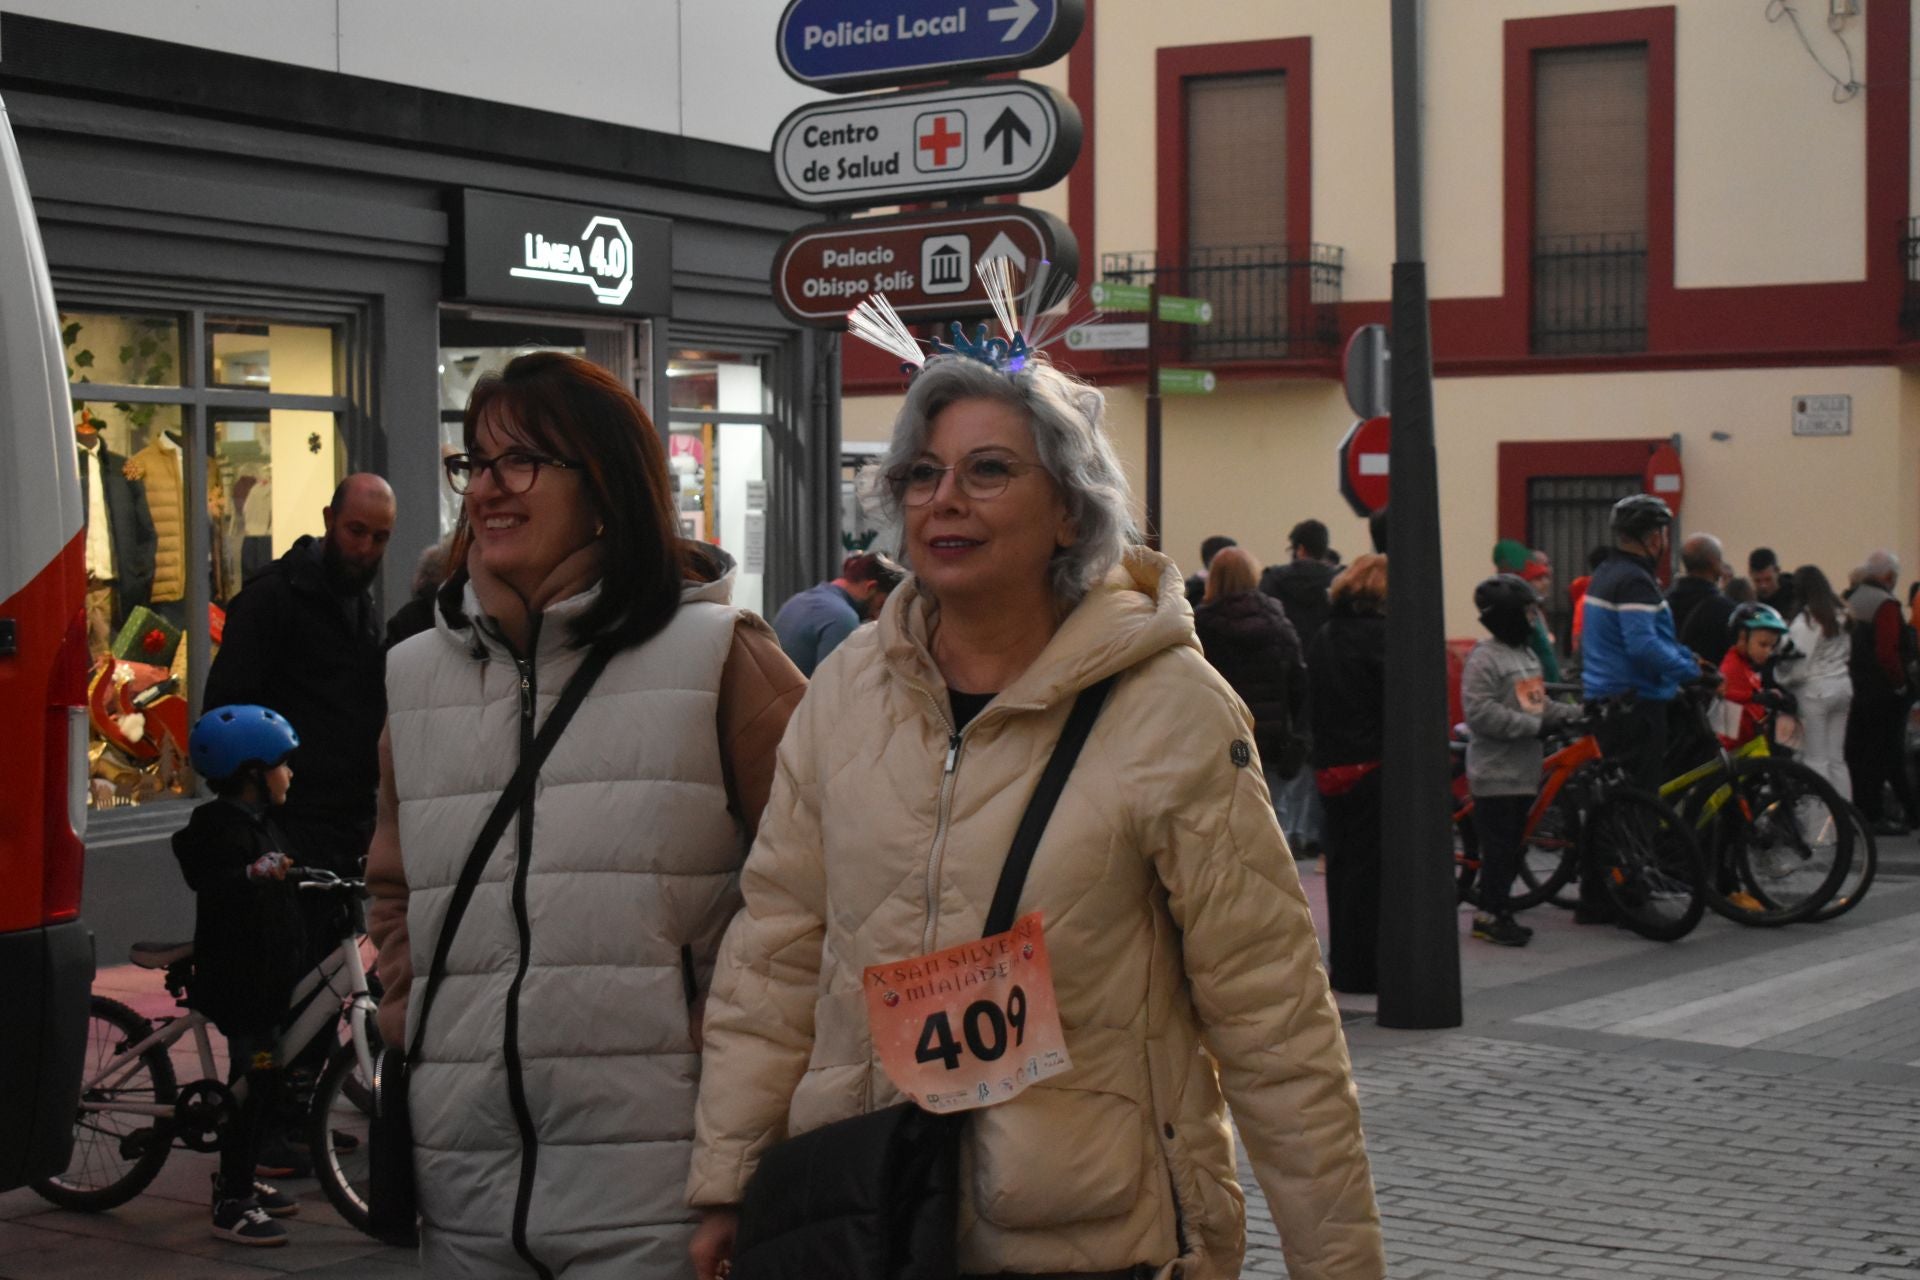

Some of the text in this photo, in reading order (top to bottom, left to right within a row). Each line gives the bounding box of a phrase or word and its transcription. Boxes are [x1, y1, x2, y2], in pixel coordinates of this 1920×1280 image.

[897, 6, 966, 39] Local
[803, 123, 879, 148] Centro
[803, 151, 899, 182] de Salud
[589, 235, 625, 278] 4.0
[823, 245, 894, 269] Palacio
[802, 269, 914, 298] Obispo Solís
[872, 971, 887, 986] X
[914, 984, 1027, 1071] 409
